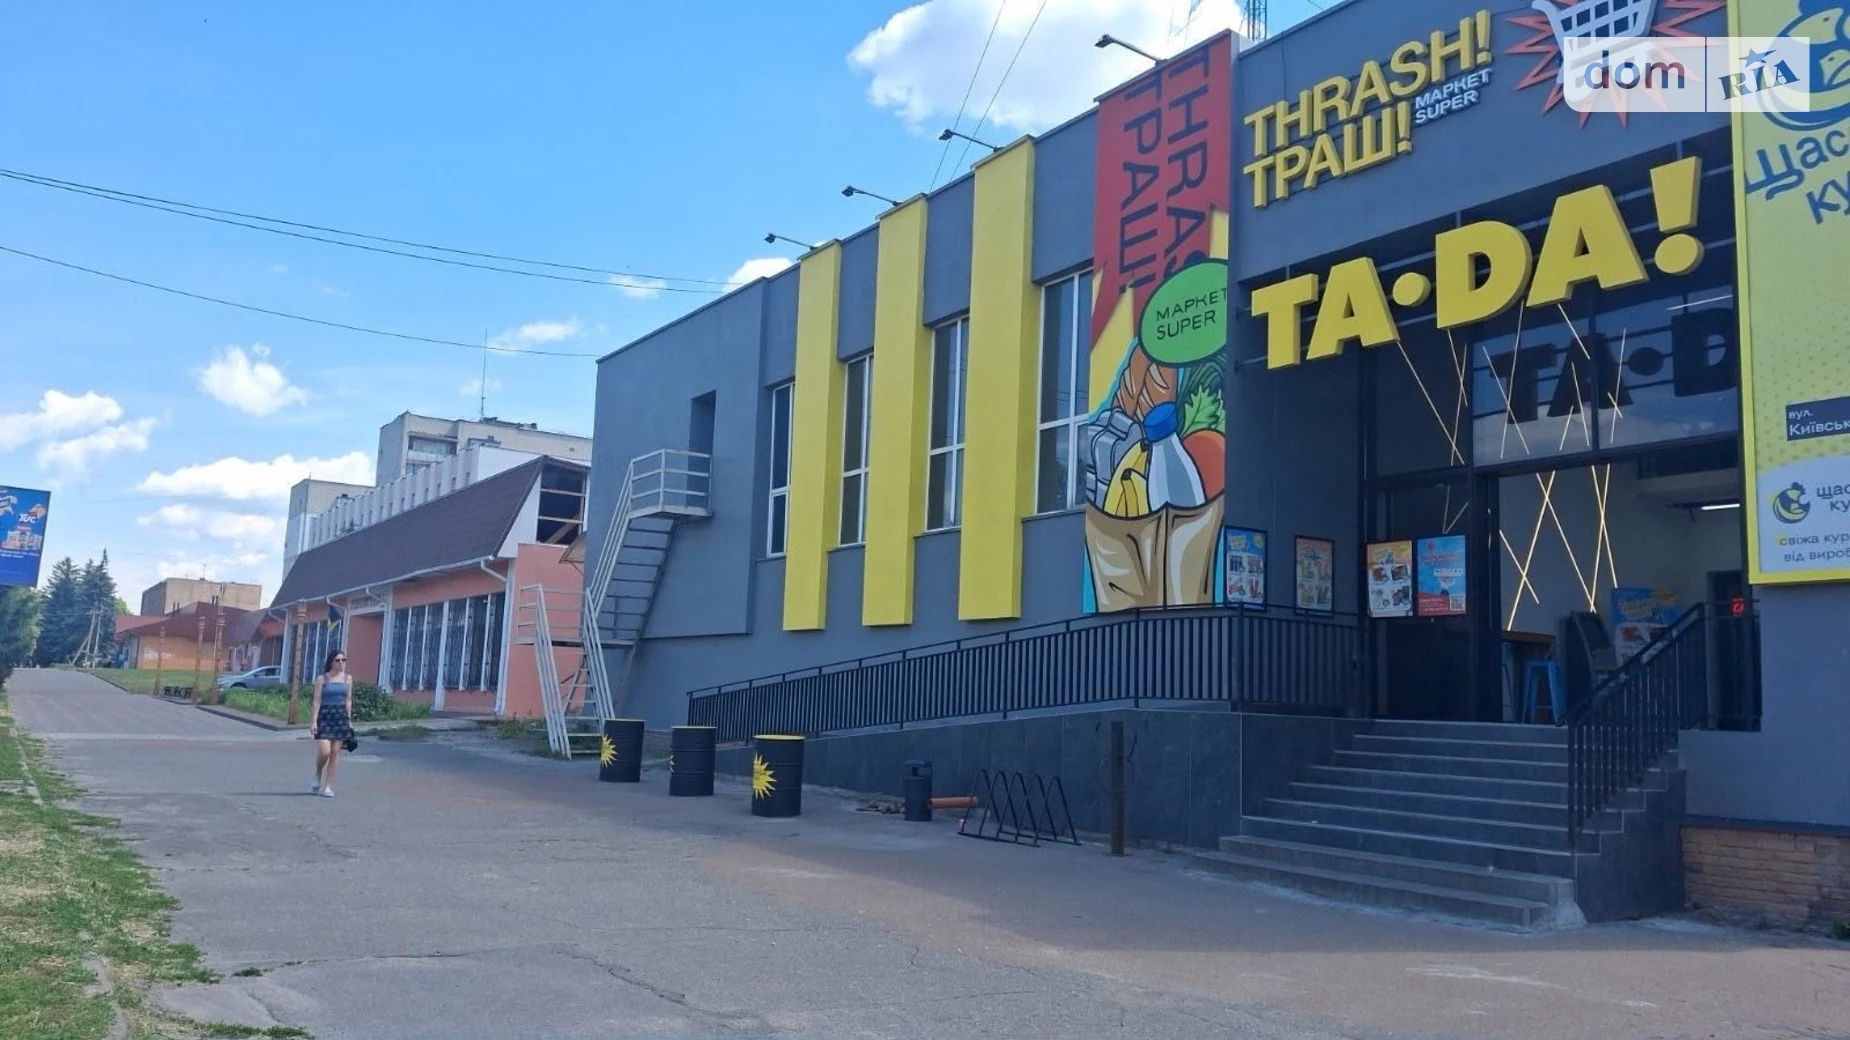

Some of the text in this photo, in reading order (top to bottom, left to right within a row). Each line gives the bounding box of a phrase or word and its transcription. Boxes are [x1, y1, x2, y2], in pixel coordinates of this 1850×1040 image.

[1244, 9, 1493, 157] THRASH!
[1415, 68, 1493, 109] МАРКЕТ
[1415, 90, 1479, 124] SUPER
[1243, 101, 1413, 209] ТРАШ!
[1157, 287, 1228, 321] МАРКЕТ
[1157, 310, 1216, 340] SUPER
[1789, 409, 1814, 420] вул.
[19, 513, 36, 524] TUC
[1780, 533, 1849, 546] свіжа кур
[1784, 551, 1805, 562] від
